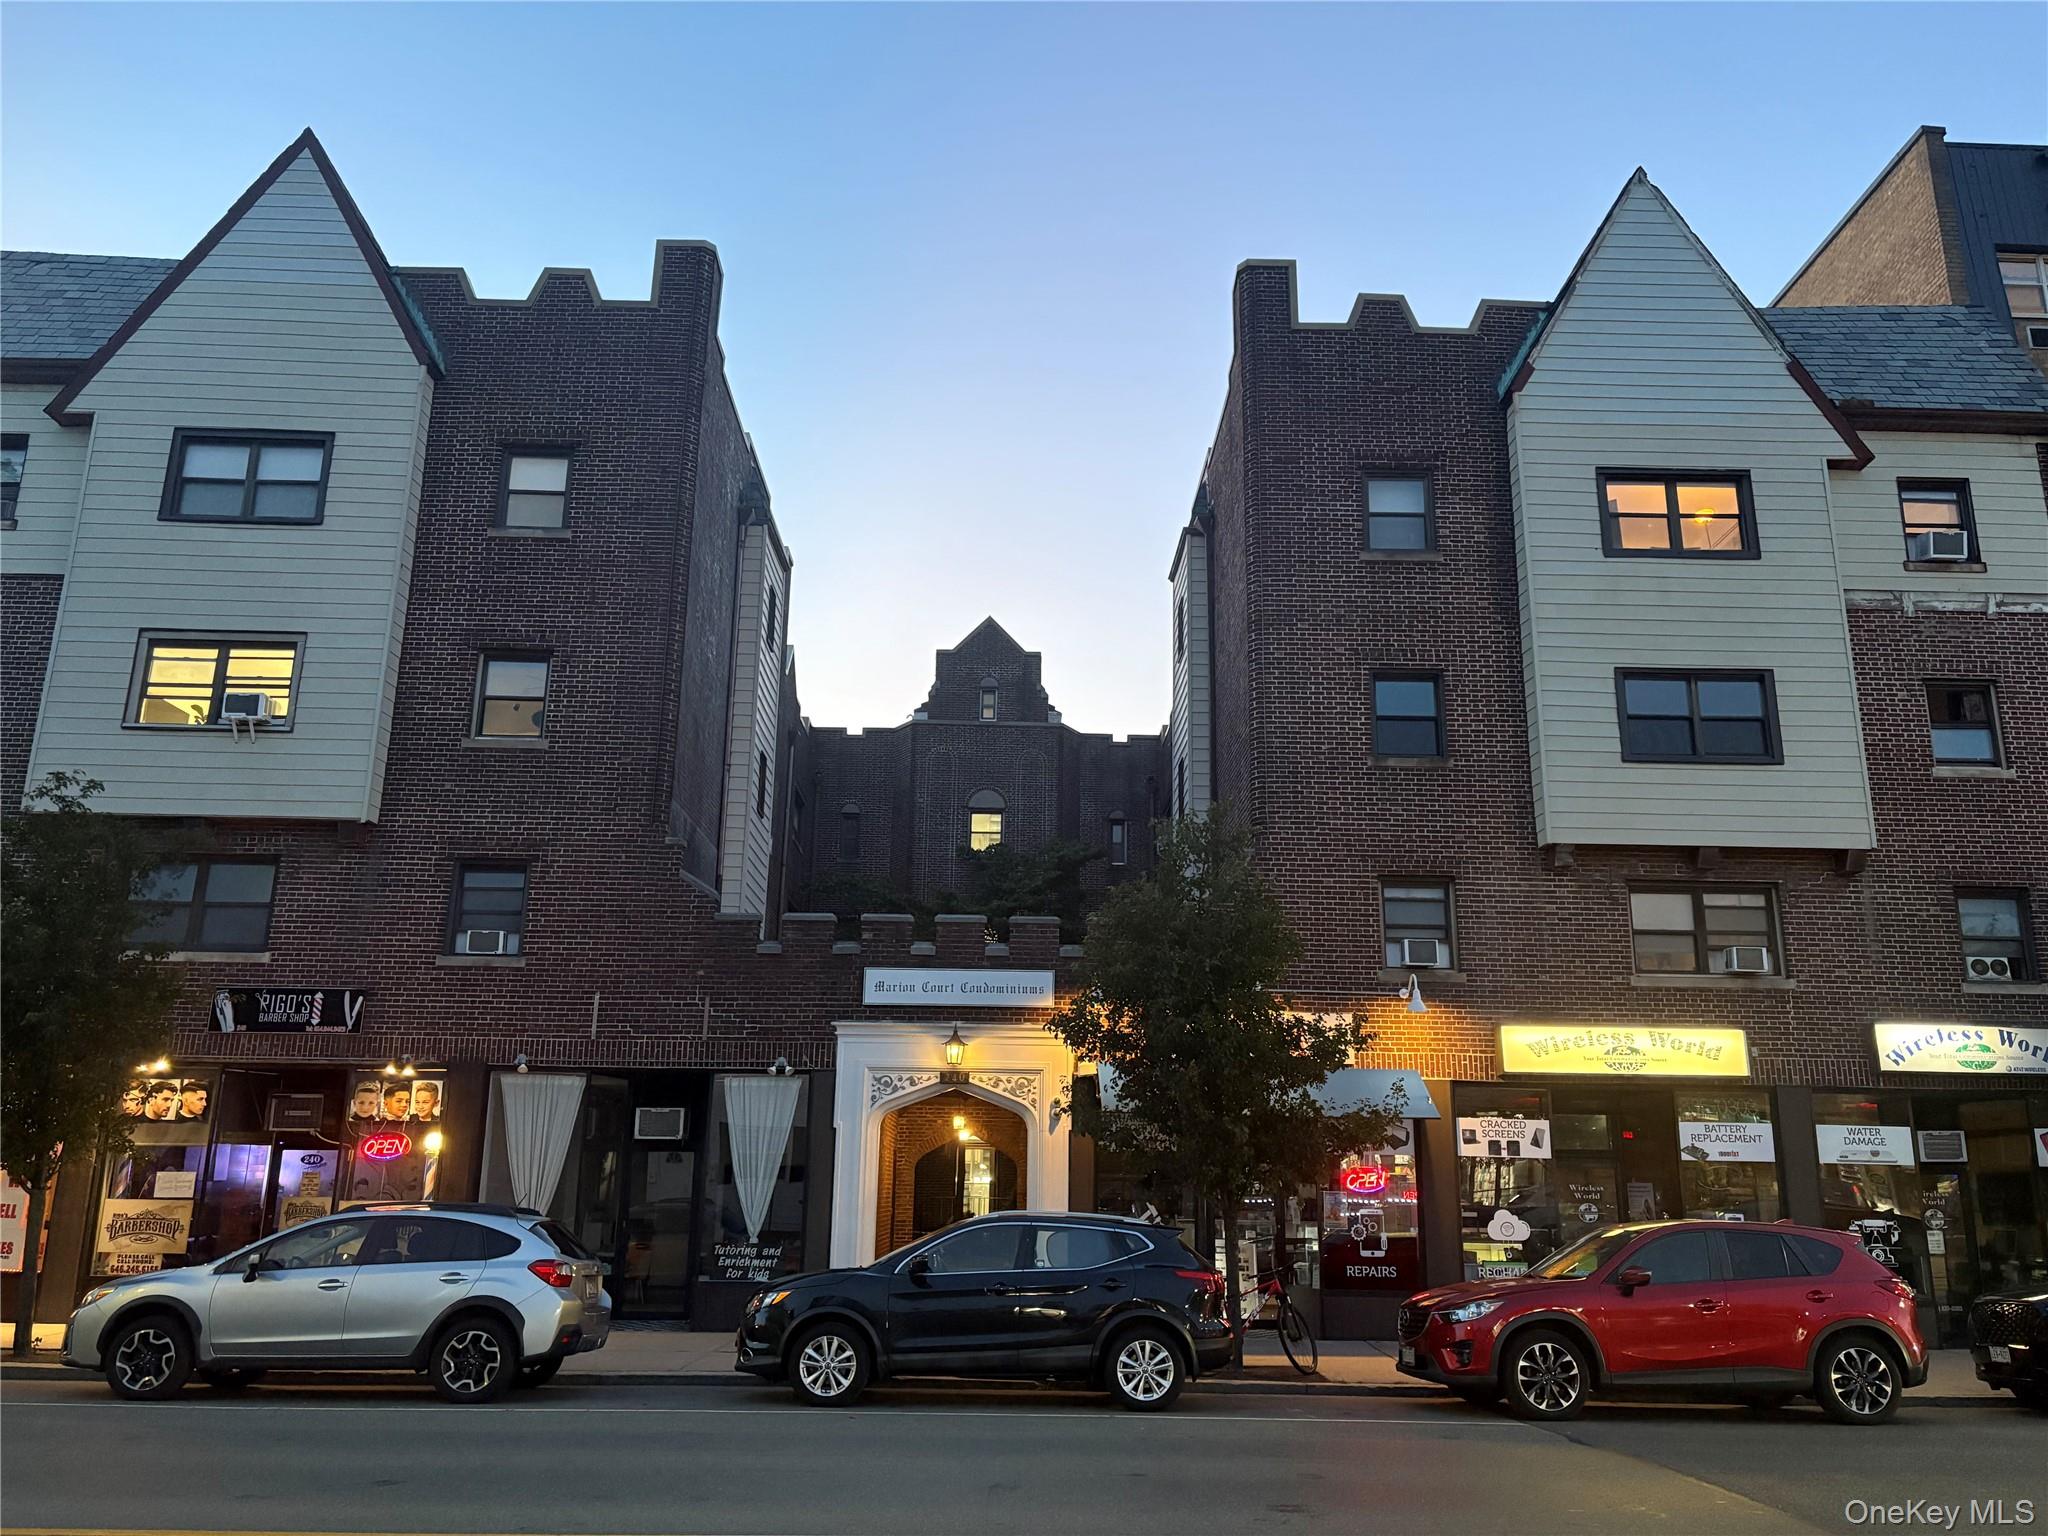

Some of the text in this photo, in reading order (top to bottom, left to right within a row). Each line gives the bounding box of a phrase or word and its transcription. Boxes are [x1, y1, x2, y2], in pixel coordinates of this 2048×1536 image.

[874, 980, 1045, 994] Marion Court Condominiums
[259, 994, 312, 1013] RIGO'S
[258, 1013, 310, 1023] BARBER SHOP
[1526, 1030, 1723, 1061] Wireless World
[1885, 1028, 1984, 1067] Wireless
[1480, 1119, 1527, 1130] CRACKED
[1704, 1124, 1748, 1133] BATTERY
[1481, 1129, 1526, 1139] SCREENS
[1846, 1127, 1882, 1137] WATER
[1690, 1134, 1763, 1143] REPLACEMENT
[1843, 1137, 1887, 1146] DAMAGE
[364, 1139, 407, 1154] OPEN
[303, 1155, 320, 1163] 240
[1574, 1192, 1600, 1200] World
[109, 1218, 180, 1241] BARBERSHOP
[714, 1244, 782, 1257] Tutoring and
[718, 1256, 778, 1267] Enrichment
[726, 1267, 770, 1279] for kids
[1346, 1265, 1397, 1278] REPAIRS
